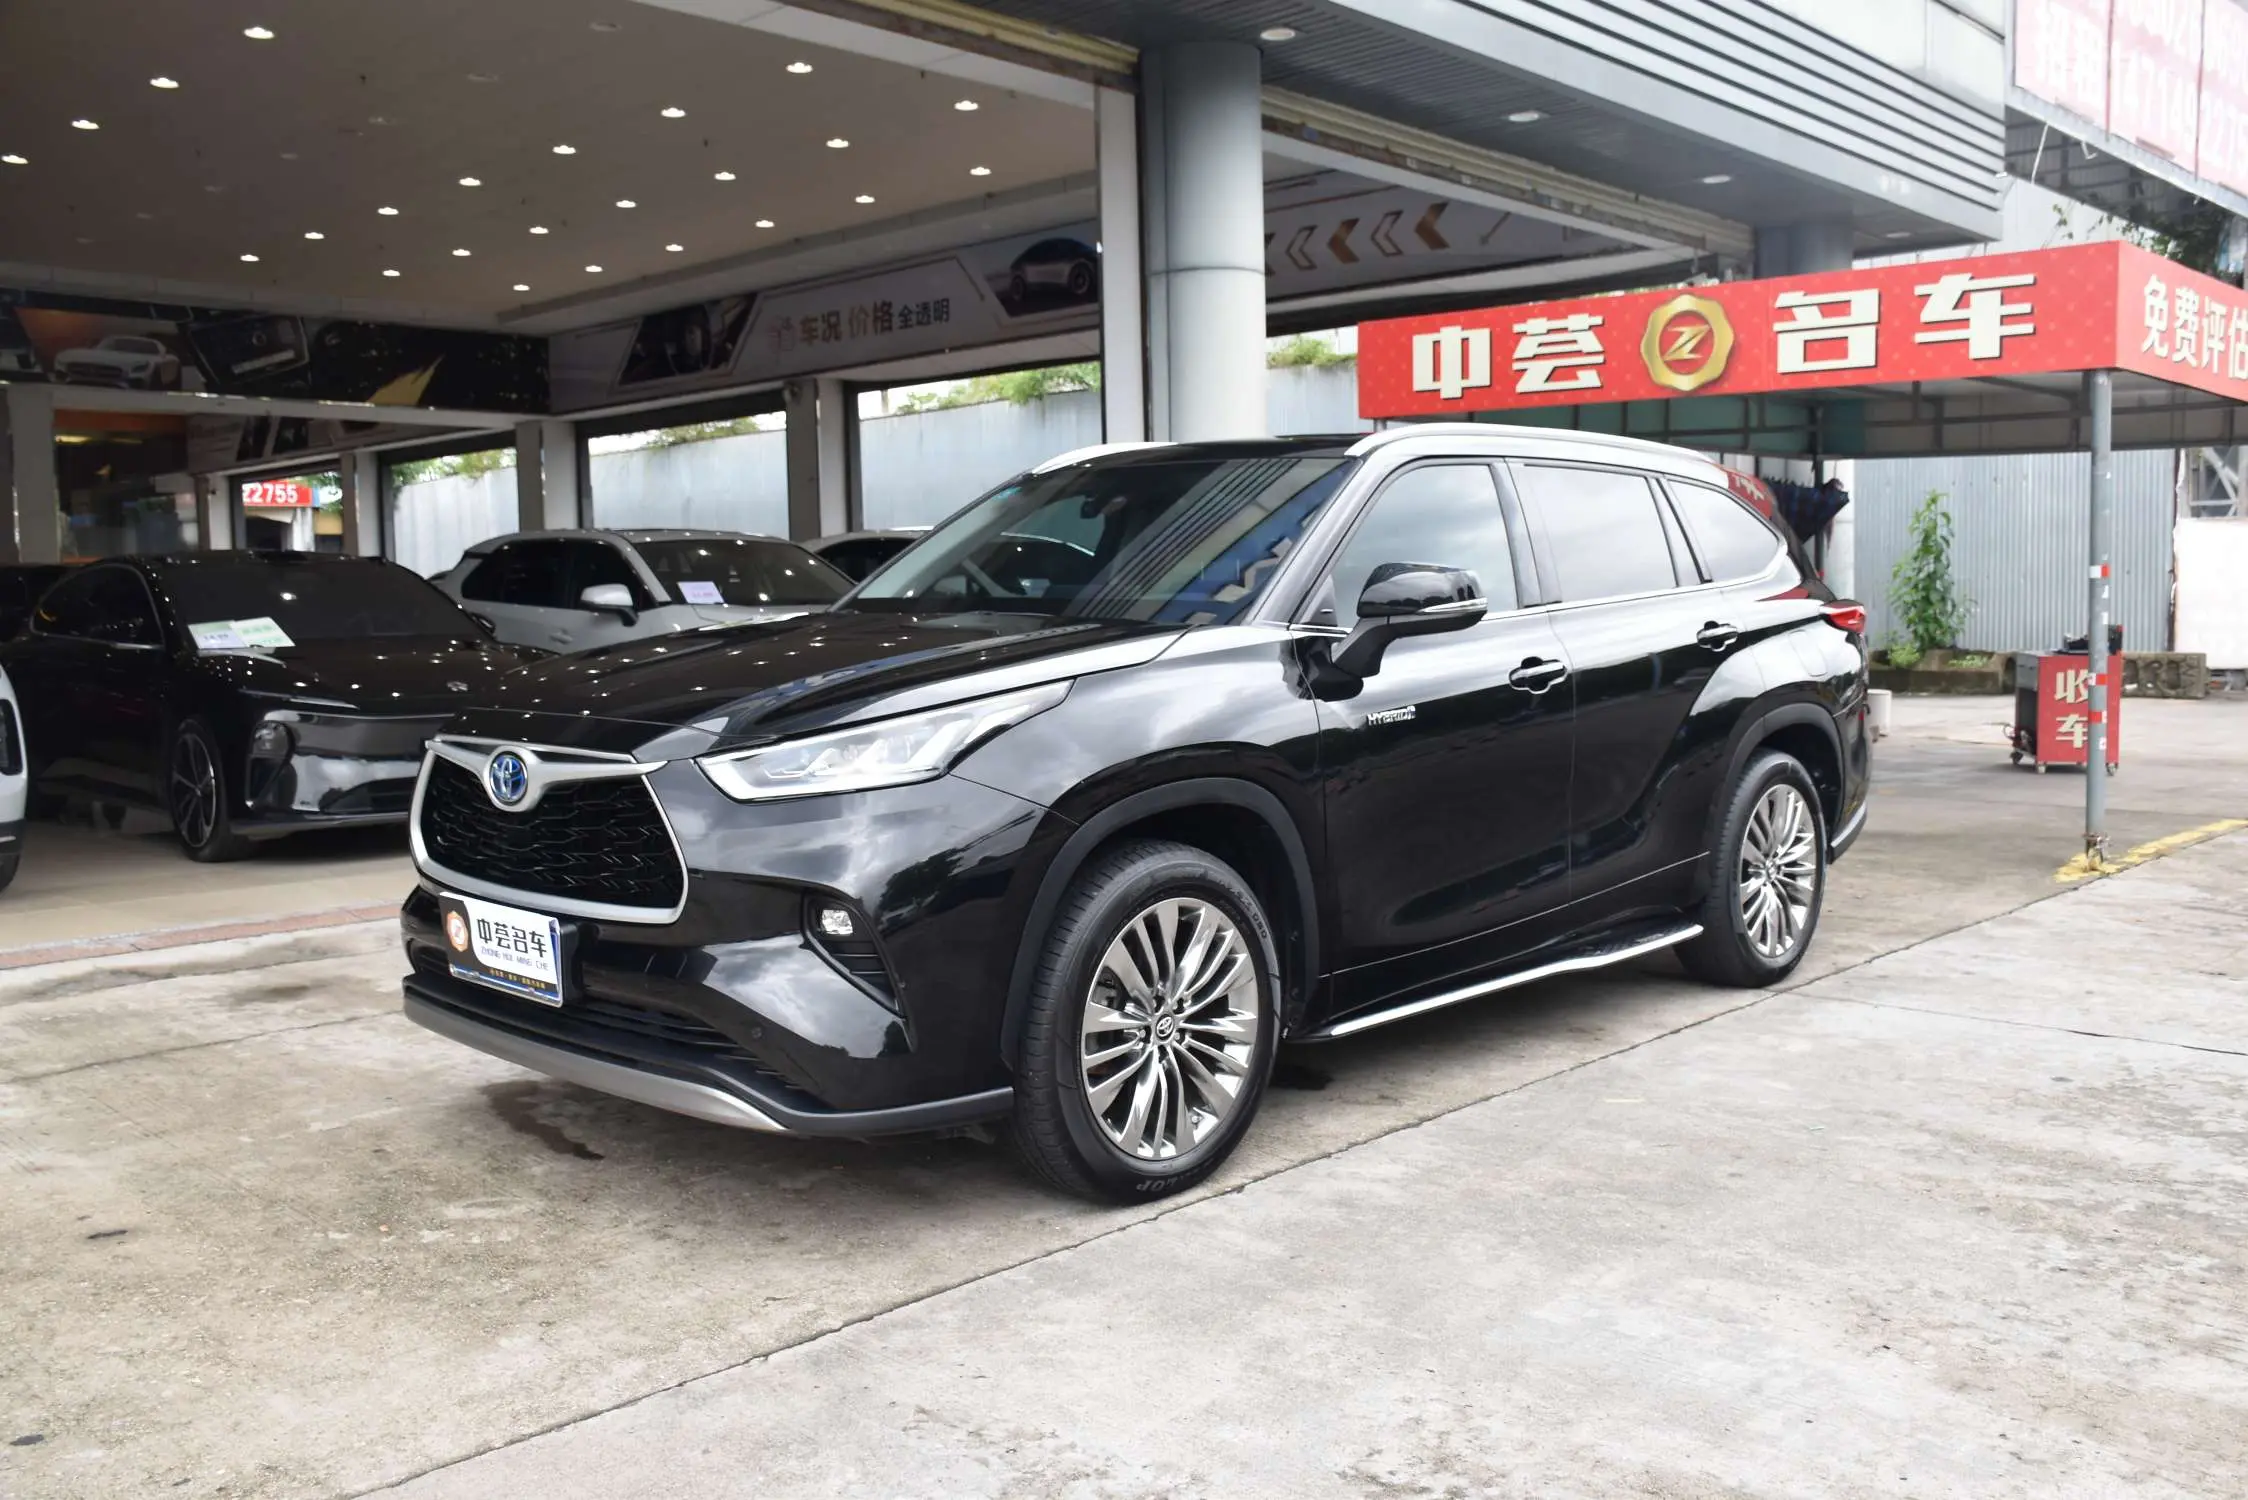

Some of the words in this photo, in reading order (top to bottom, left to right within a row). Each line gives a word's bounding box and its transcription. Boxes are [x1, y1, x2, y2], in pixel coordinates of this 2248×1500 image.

[898, 298, 951, 331] 全透明
[1412, 313, 1606, 400] 中荟
[1773, 272, 2037, 375] 名车
[2141, 273, 2248, 381] 免费评估
[2054, 668, 2089, 749] 收车
[476, 918, 548, 958] 中荟名车
